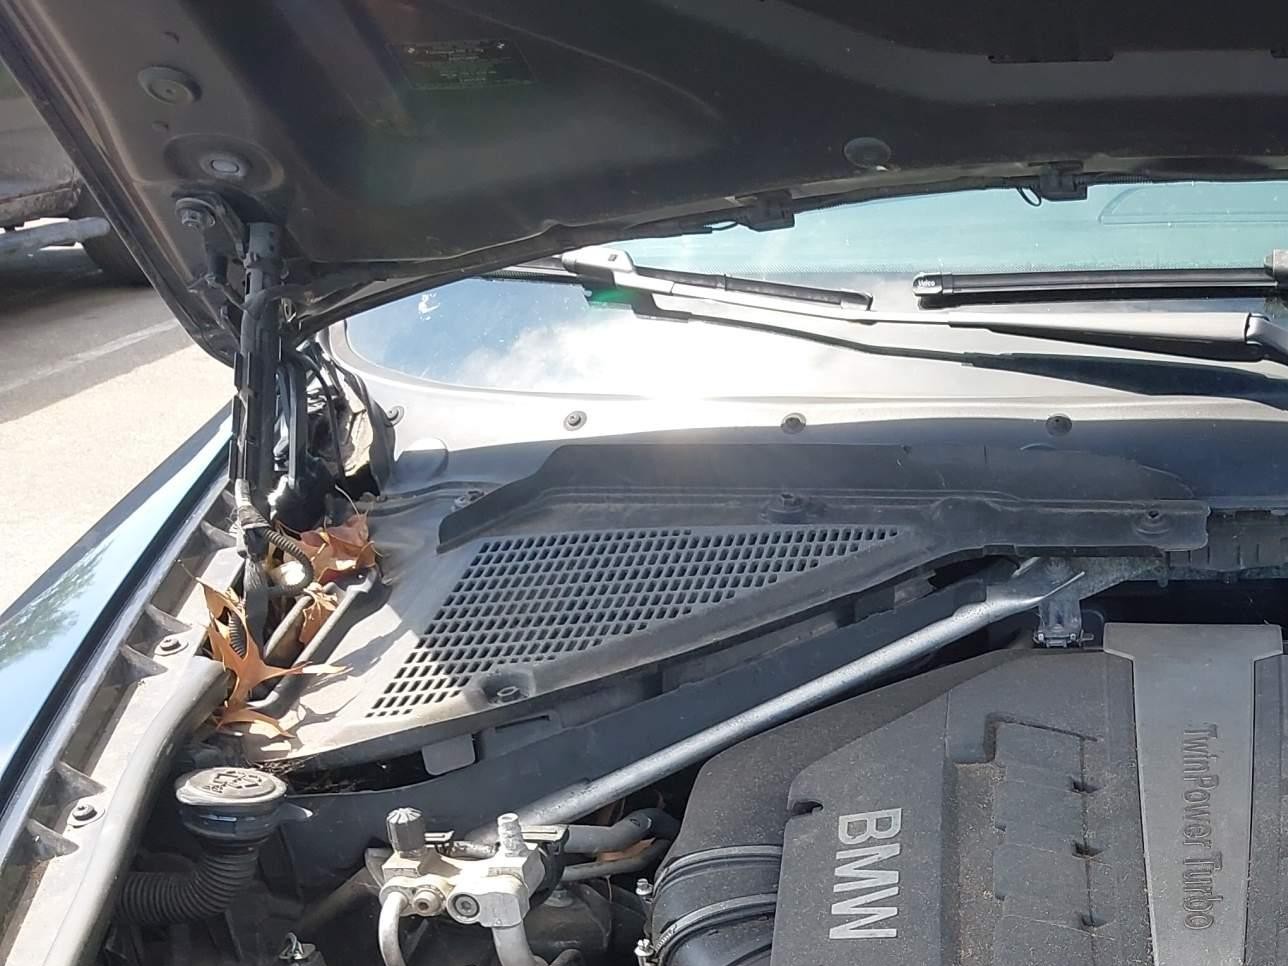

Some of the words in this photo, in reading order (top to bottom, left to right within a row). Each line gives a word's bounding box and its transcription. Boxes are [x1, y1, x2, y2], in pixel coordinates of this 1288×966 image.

[1183, 723, 1220, 849] TwinPower
[828, 807, 902, 940] BMW
[1182, 851, 1224, 930] Turbo
